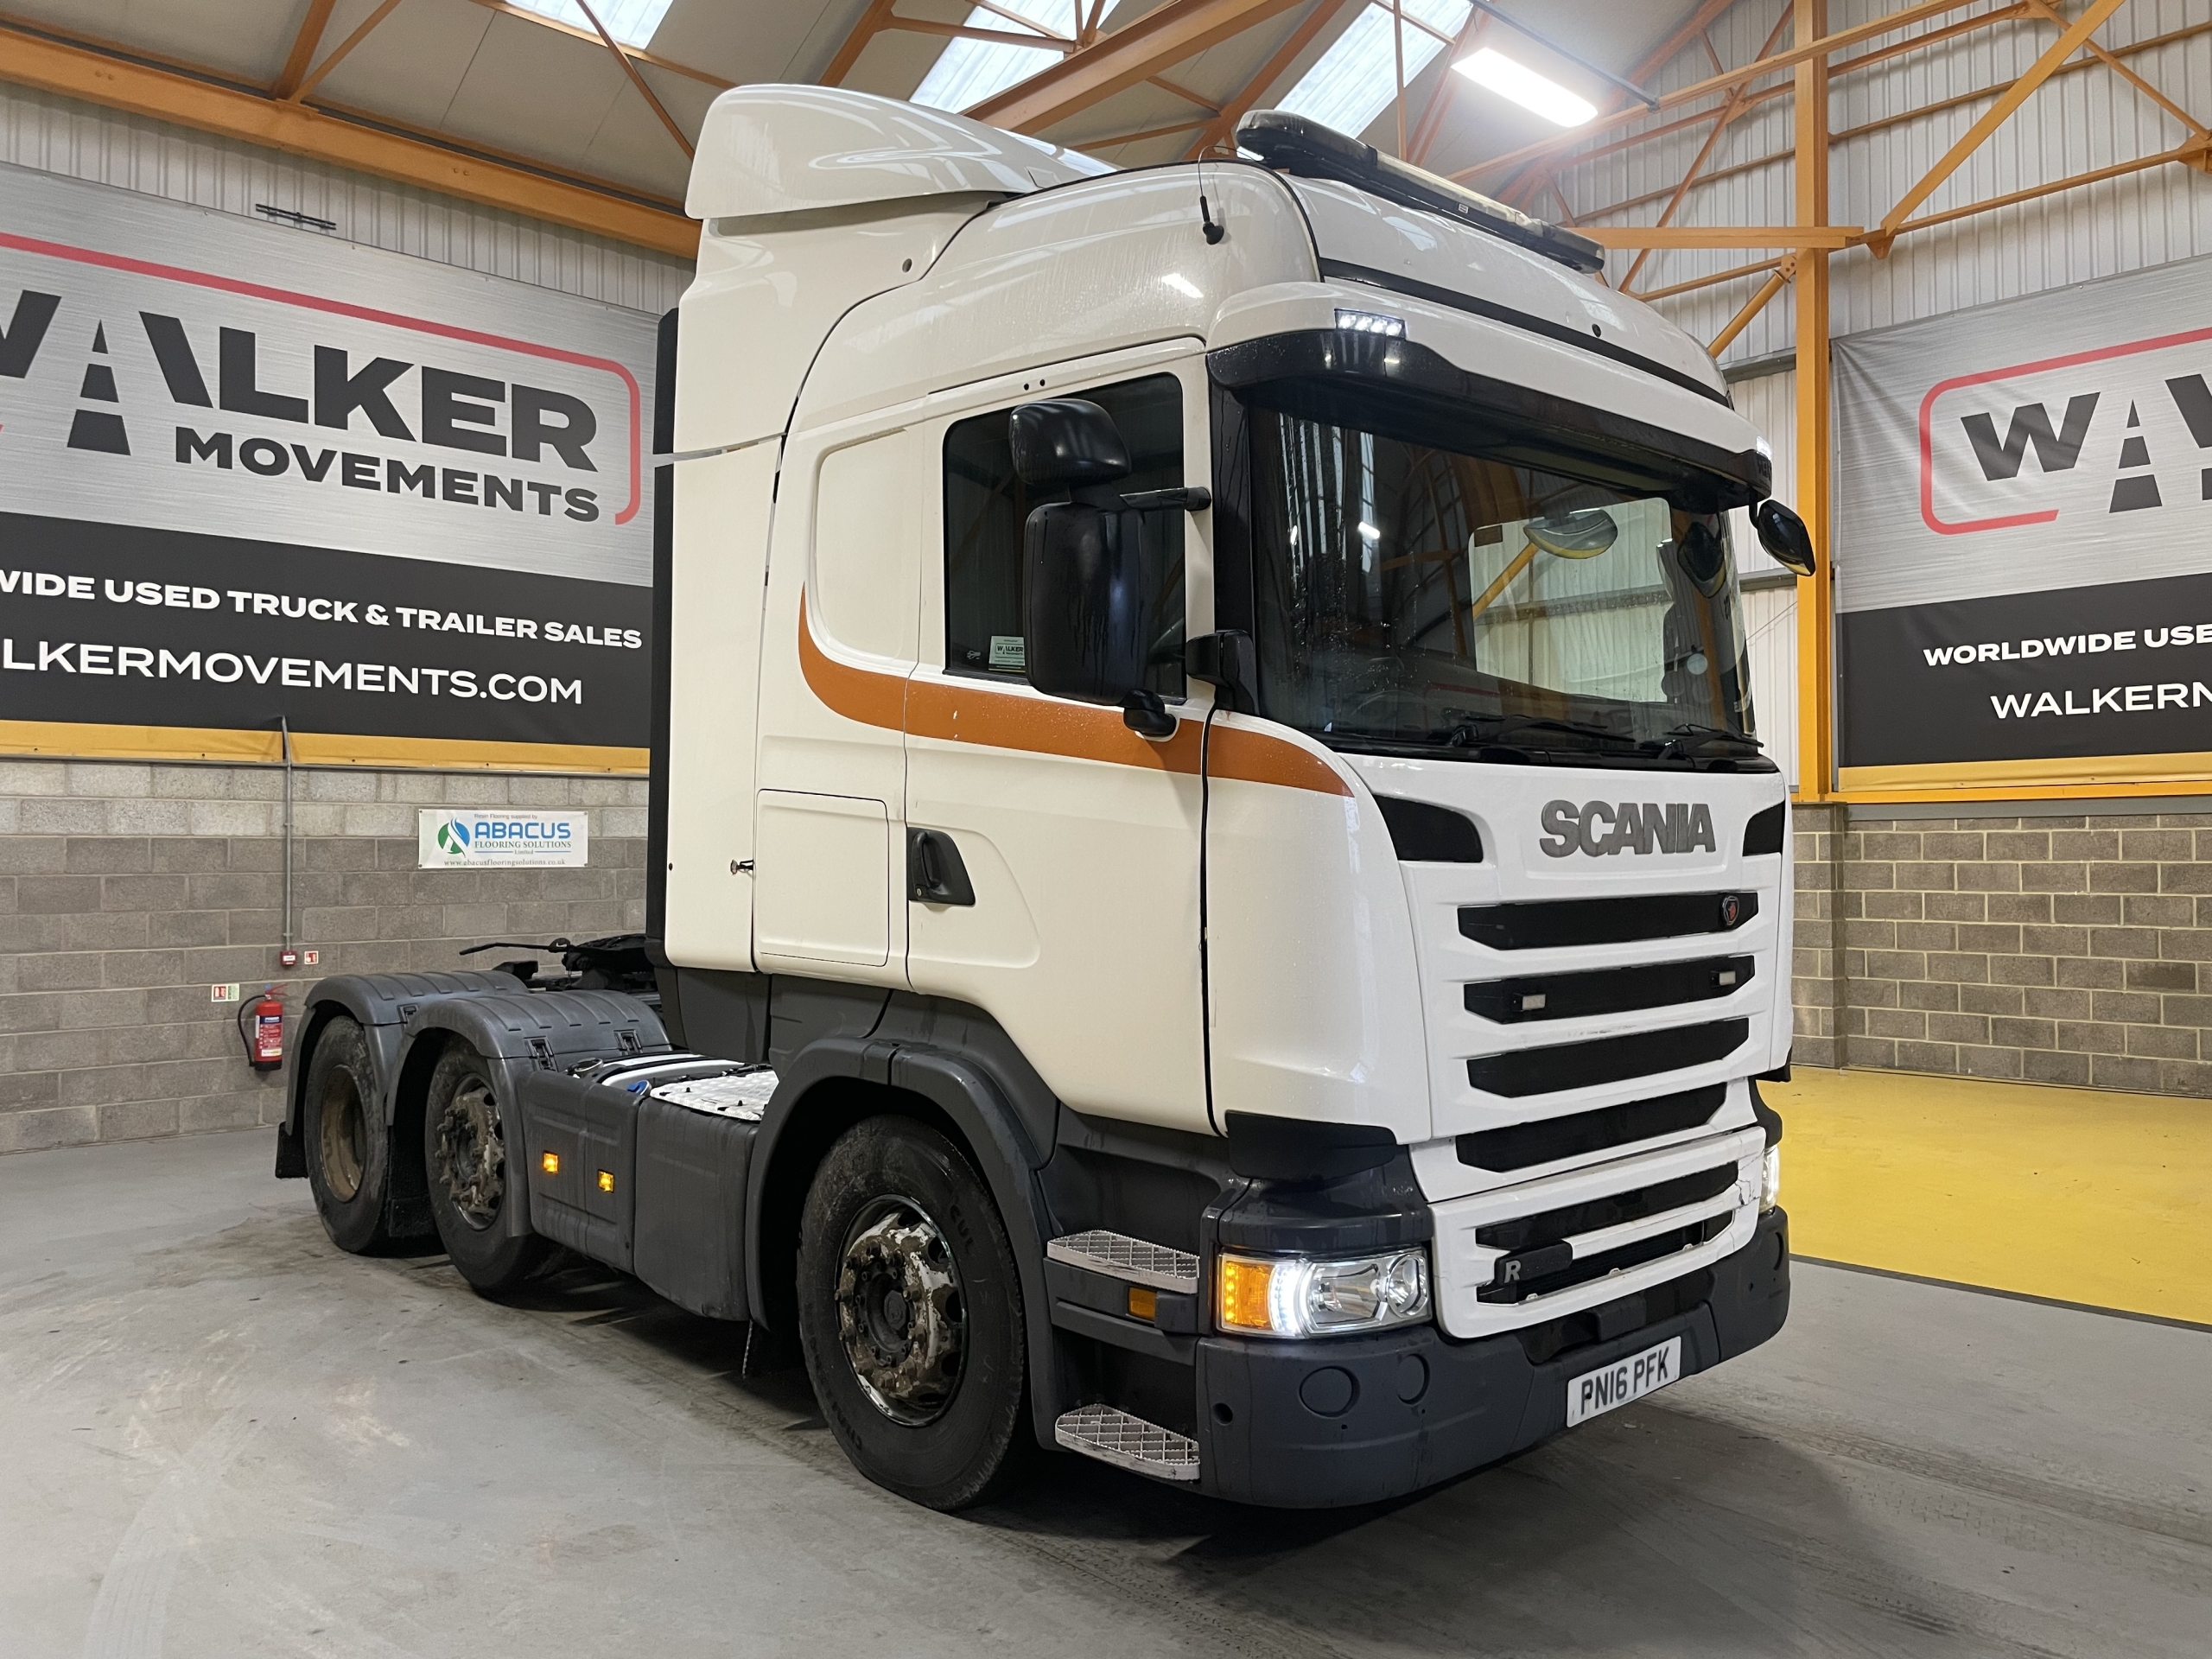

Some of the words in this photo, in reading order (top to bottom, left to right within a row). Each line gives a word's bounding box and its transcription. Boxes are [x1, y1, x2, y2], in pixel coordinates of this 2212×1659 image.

[175, 426, 600, 523] MOVEMENTS
[105, 579, 220, 610] USED
[227, 590, 359, 624] TRUCK
[365, 604, 390, 626] &
[396, 607, 538, 639] TRAILER
[544, 622, 642, 649] SALES
[3, 638, 582, 705] LKERMOVEMENTS.COM
[1923, 630, 2137, 666] WORLDWIDE
[474, 822, 571, 839] ABACUS
[1540, 799, 1716, 858] SCANIA
[443, 858, 566, 867] www.abacusflooringsolutions.co.uk
[1503, 1260, 1521, 1284] R
[1580, 1366, 1628, 1416] PN16
[1633, 1346, 1669, 1395] PFK
